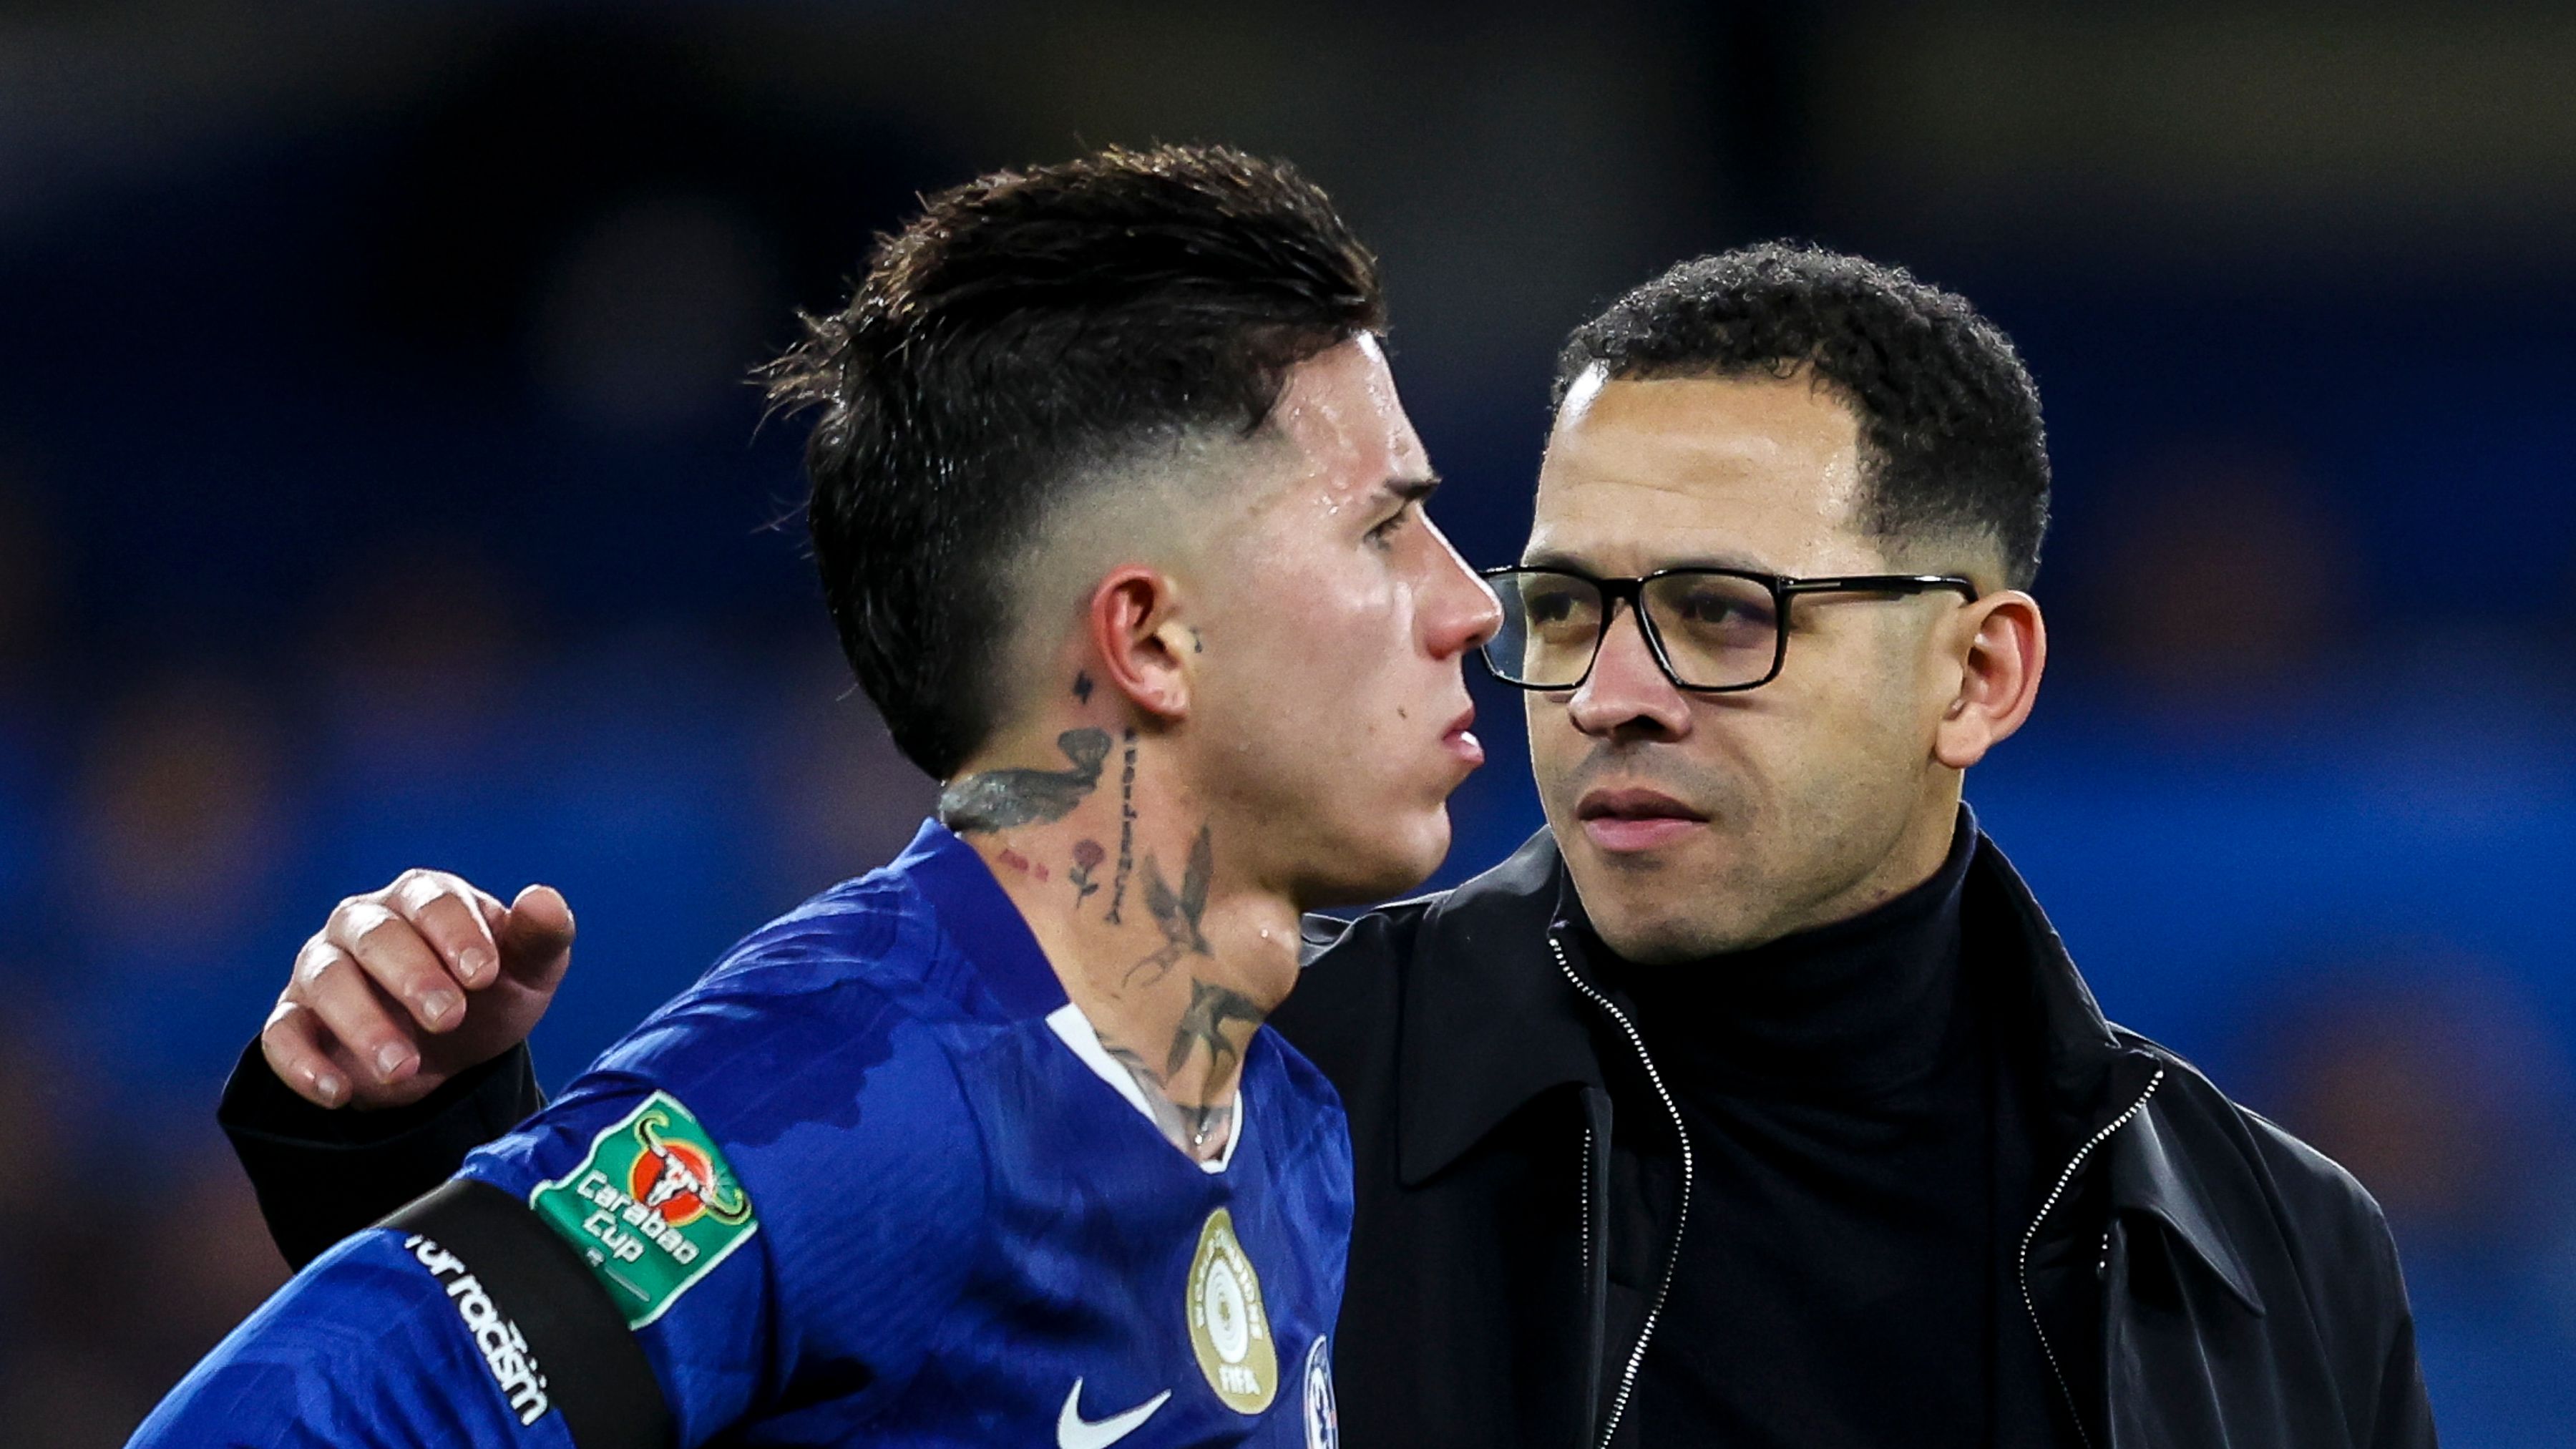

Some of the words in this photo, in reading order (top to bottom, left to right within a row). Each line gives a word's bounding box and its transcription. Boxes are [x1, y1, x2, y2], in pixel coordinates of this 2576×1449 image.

[576, 1169, 700, 1264] Carabao
[583, 1209, 644, 1262] Cup
[447, 1273, 548, 1426] racism
[1218, 1365, 1261, 1395] FIFA
